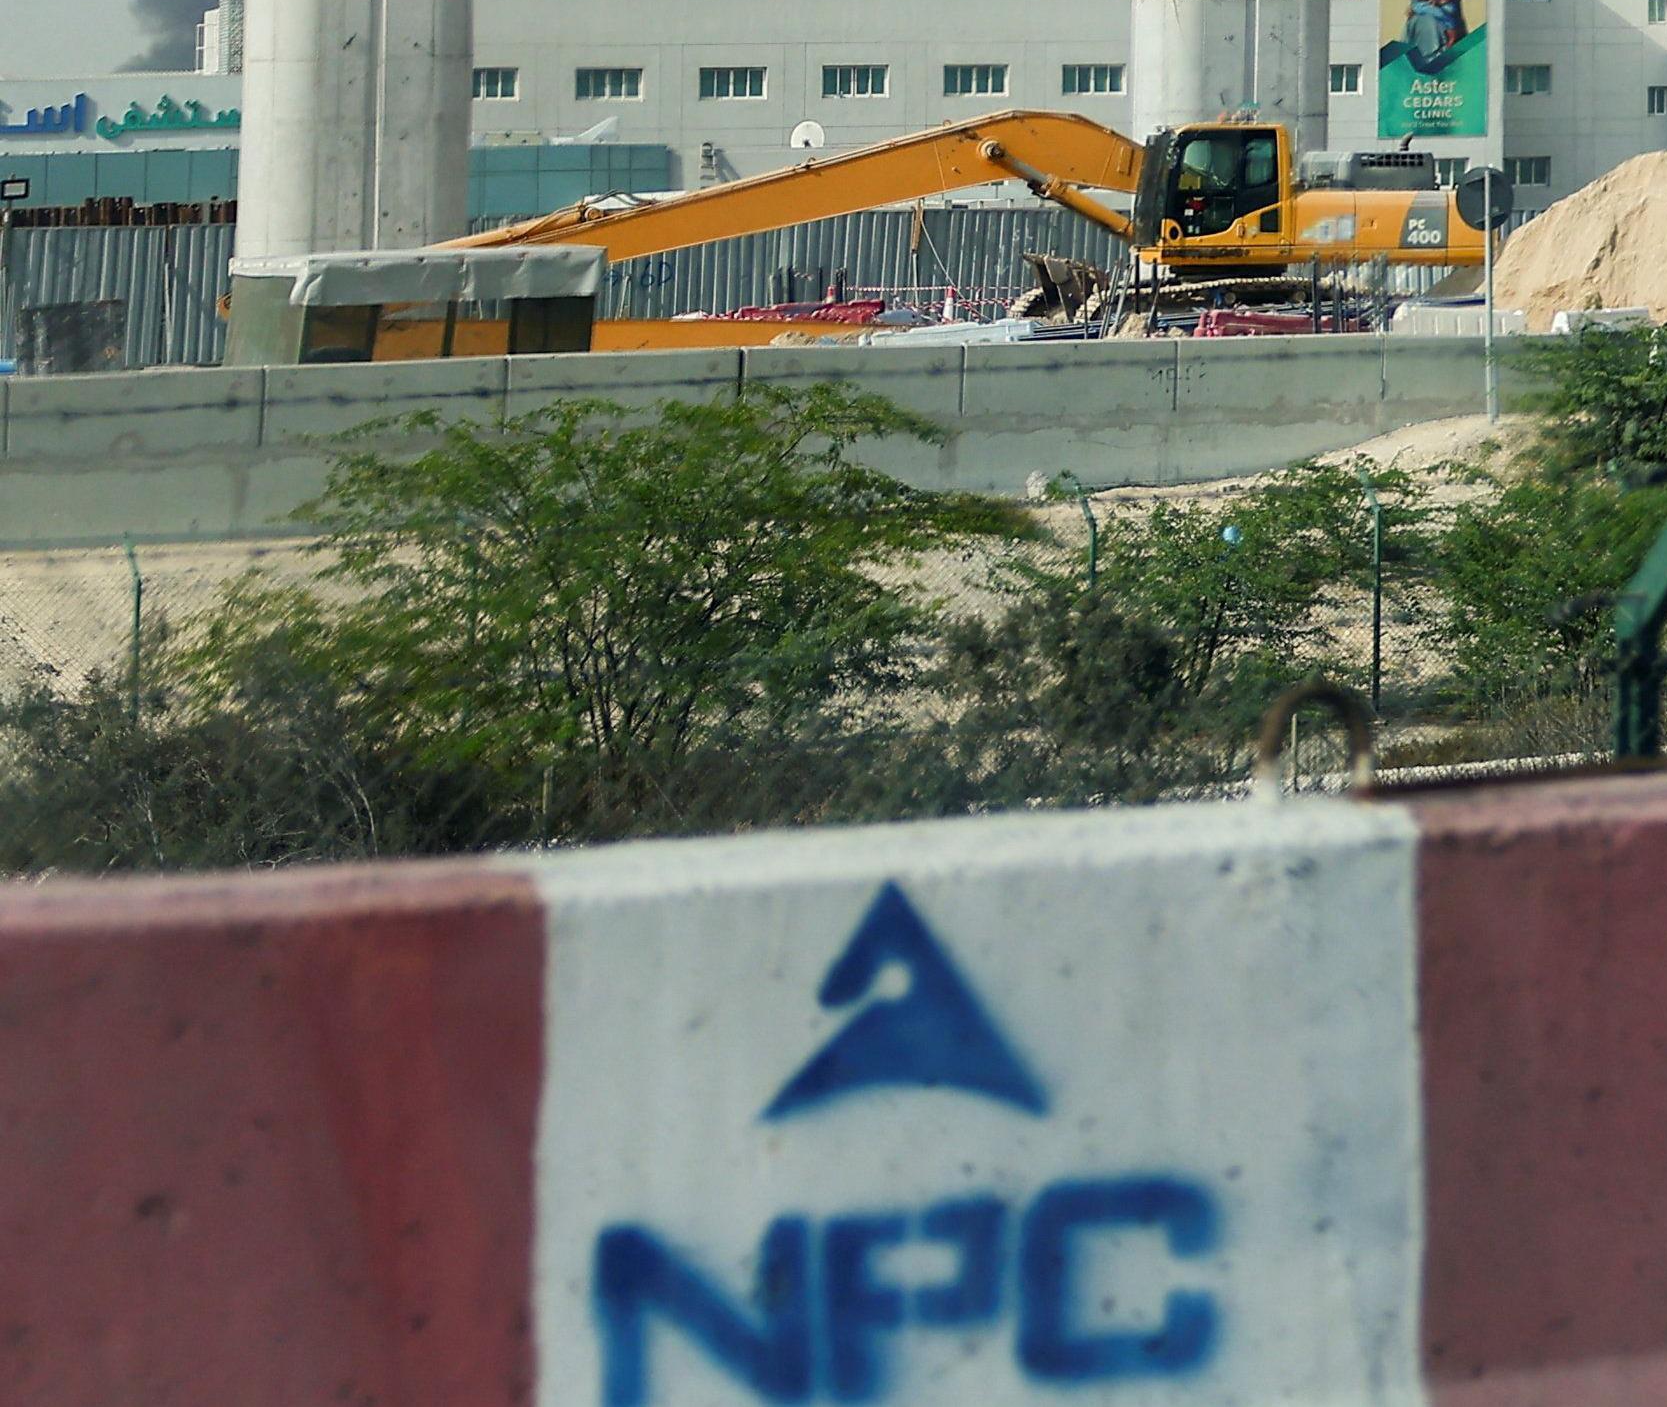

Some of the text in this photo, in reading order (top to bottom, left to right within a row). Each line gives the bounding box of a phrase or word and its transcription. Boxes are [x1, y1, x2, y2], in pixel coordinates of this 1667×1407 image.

[1409, 78, 1457, 94] Aster
[1403, 96, 1464, 108] CEDARS
[96, 94, 242, 139] ستشفى
[1413, 109, 1453, 119] CLINIC
[1408, 218, 1426, 231] PC
[1407, 230, 1442, 245] 400
[590, 1170, 1225, 1407] NPC
